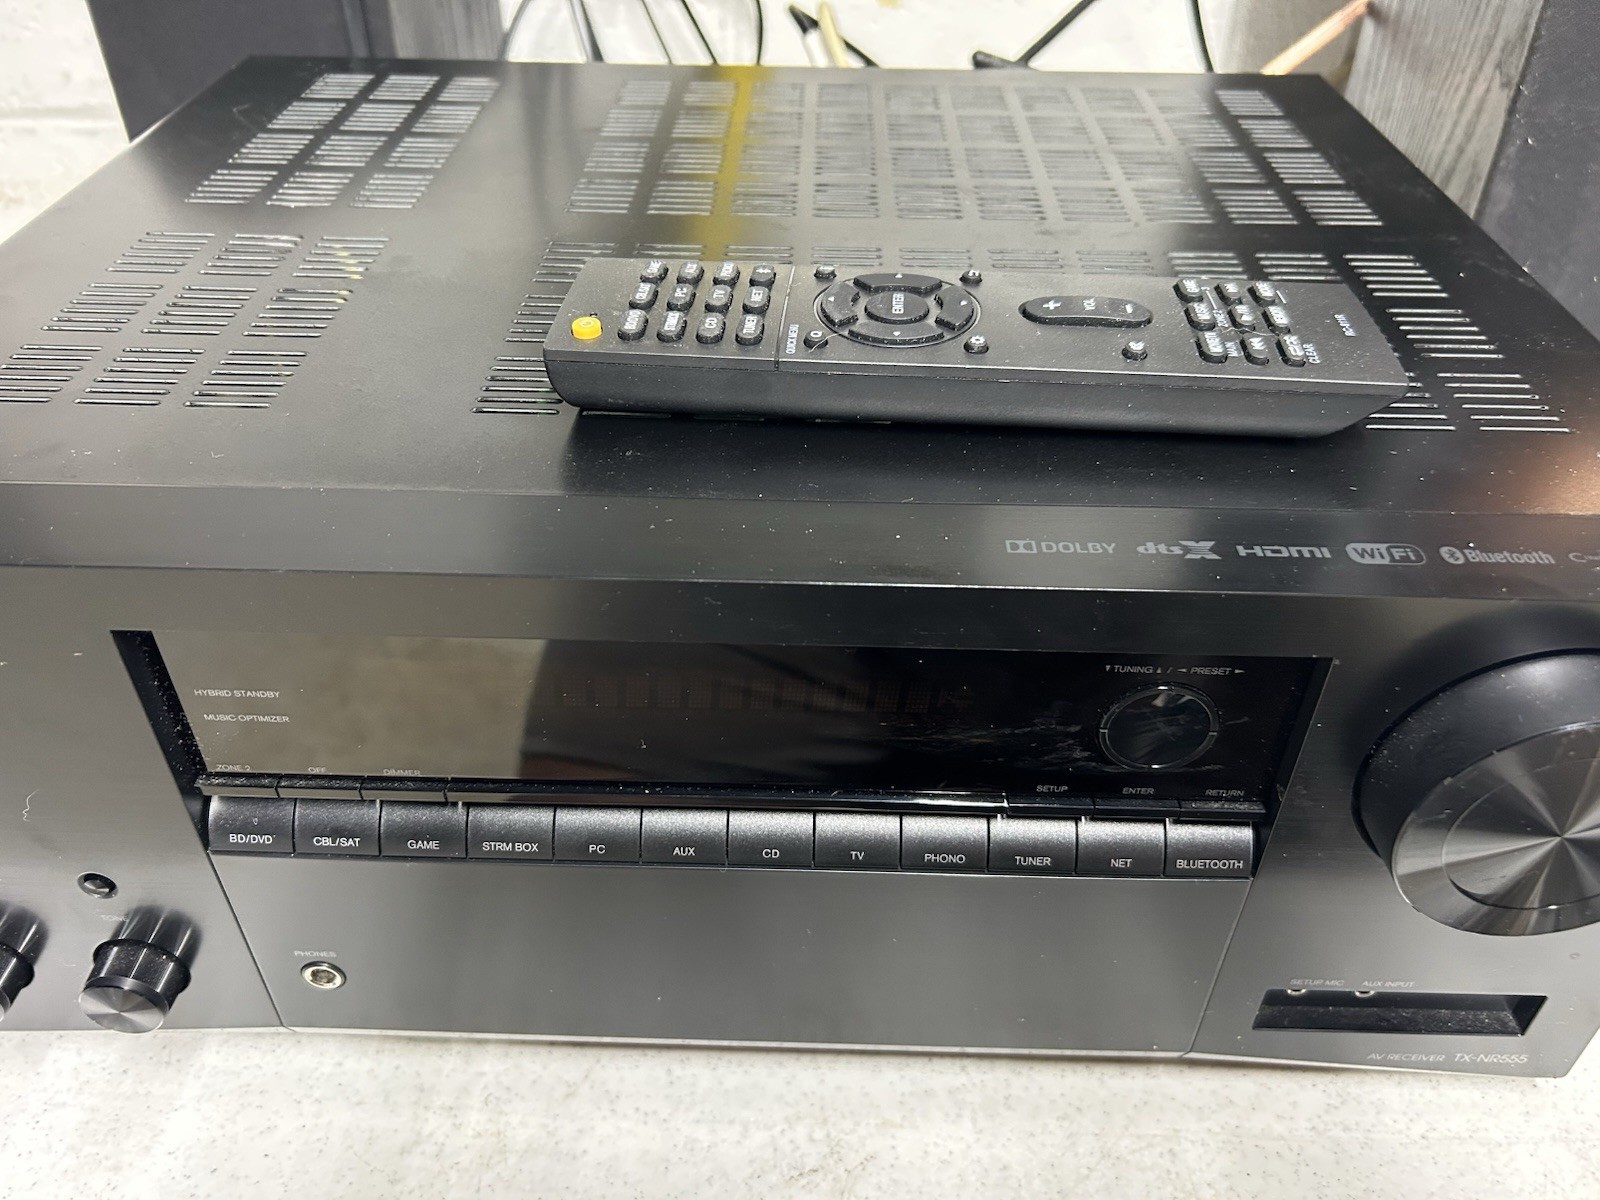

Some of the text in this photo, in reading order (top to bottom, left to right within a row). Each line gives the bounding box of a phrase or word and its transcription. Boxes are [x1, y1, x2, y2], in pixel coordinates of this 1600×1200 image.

[675, 287, 687, 297] PC
[713, 289, 726, 299] TV
[751, 288, 764, 302] NET
[891, 293, 905, 314] ENTER
[705, 317, 718, 329] CD
[743, 316, 758, 333] TUNER
[1303, 342, 1320, 364] CLEAR
[1040, 541, 1116, 554] DOLBY
[1464, 549, 1555, 564] Bluetooth
[1113, 665, 1153, 674] TUNING
[1190, 667, 1233, 675] PRESET
[193, 688, 280, 698] HYBRID STANDBY
[203, 713, 290, 723] MUSIC OPTIMIZER
[216, 764, 242, 772] ZONE
[382, 768, 421, 776] DIMMER
[1036, 784, 1069, 793] SETUP
[1122, 787, 1155, 795] ENTER
[1205, 788, 1245, 797] RETURN
[229, 833, 273, 844] BD/DVD
[313, 836, 361, 847] CBL/SAT
[407, 839, 440, 850] GAME
[482, 841, 539, 852] STRM BOX
[588, 844, 606, 854] PC
[673, 846, 696, 856] AUX
[762, 848, 780, 859] CD
[850, 851, 865, 860] TV
[924, 853, 966, 864] PHONO
[1015, 856, 1051, 866] TUNER
[1110, 858, 1133, 868] NET
[1176, 859, 1244, 870] BLUETOOTH
[1366, 1053, 1529, 1064] AV RECEIVER TX-NR555
